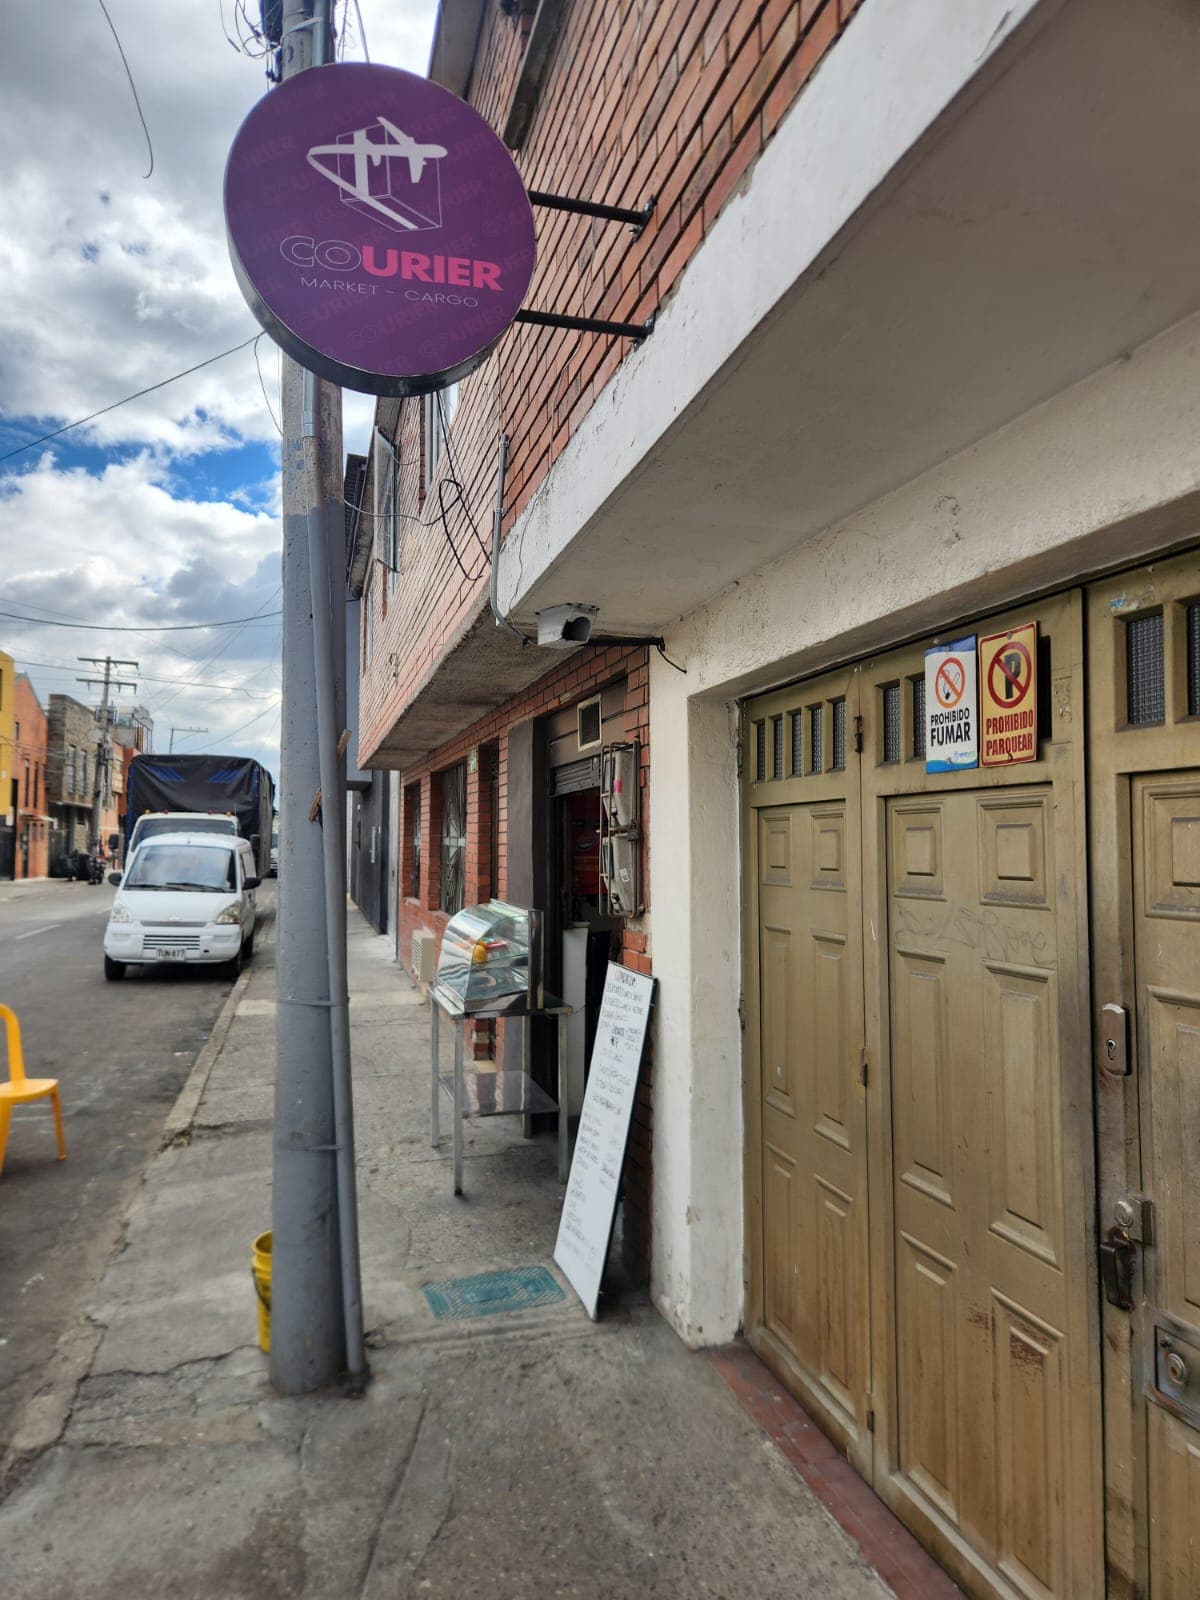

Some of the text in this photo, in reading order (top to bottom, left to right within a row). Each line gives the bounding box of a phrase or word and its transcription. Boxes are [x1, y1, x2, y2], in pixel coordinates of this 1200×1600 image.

[280, 235, 504, 291] COURIER
[300, 277, 379, 295] MARKET
[405, 290, 478, 308] CARGO
[930, 708, 970, 727] PROHIBIDO
[986, 709, 1034, 735] PROHIBIDO
[930, 722, 971, 747] FUMAR
[986, 733, 1033, 756] PARQUEAR
